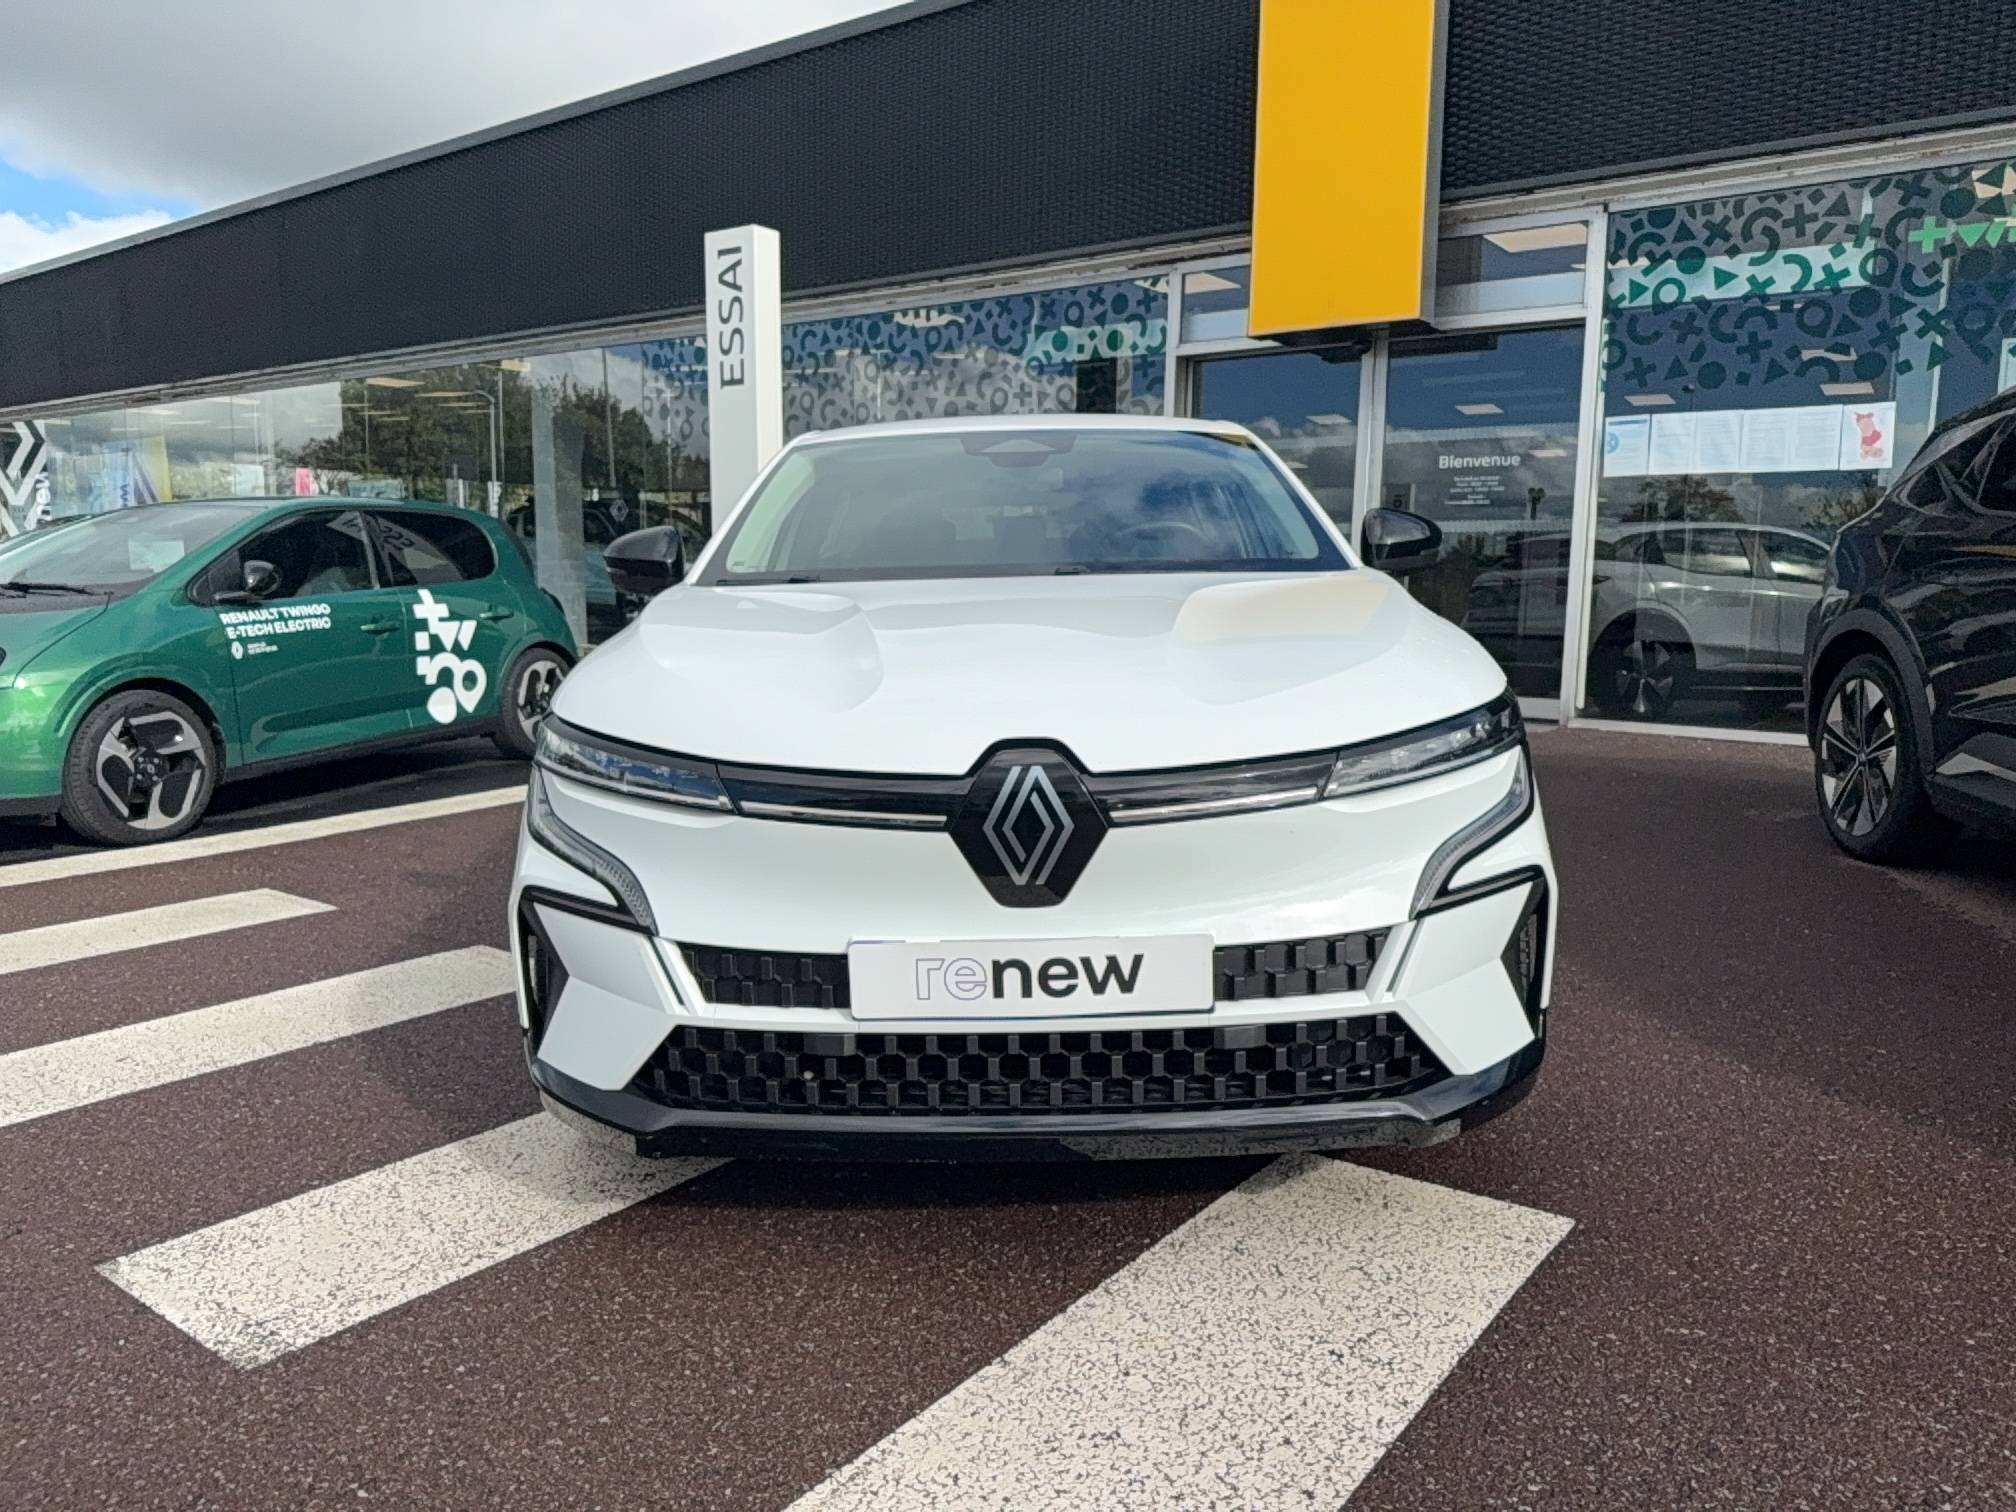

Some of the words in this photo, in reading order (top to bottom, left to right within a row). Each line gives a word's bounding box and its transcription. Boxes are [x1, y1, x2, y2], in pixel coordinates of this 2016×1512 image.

[716, 245, 745, 389] ESSAI
[1438, 455, 1522, 470] Bienvenue
[219, 607, 279, 625] RENAULT
[280, 603, 331, 618] TWINGO
[225, 622, 274, 640] E-TECH
[915, 953, 1145, 1001] renew
